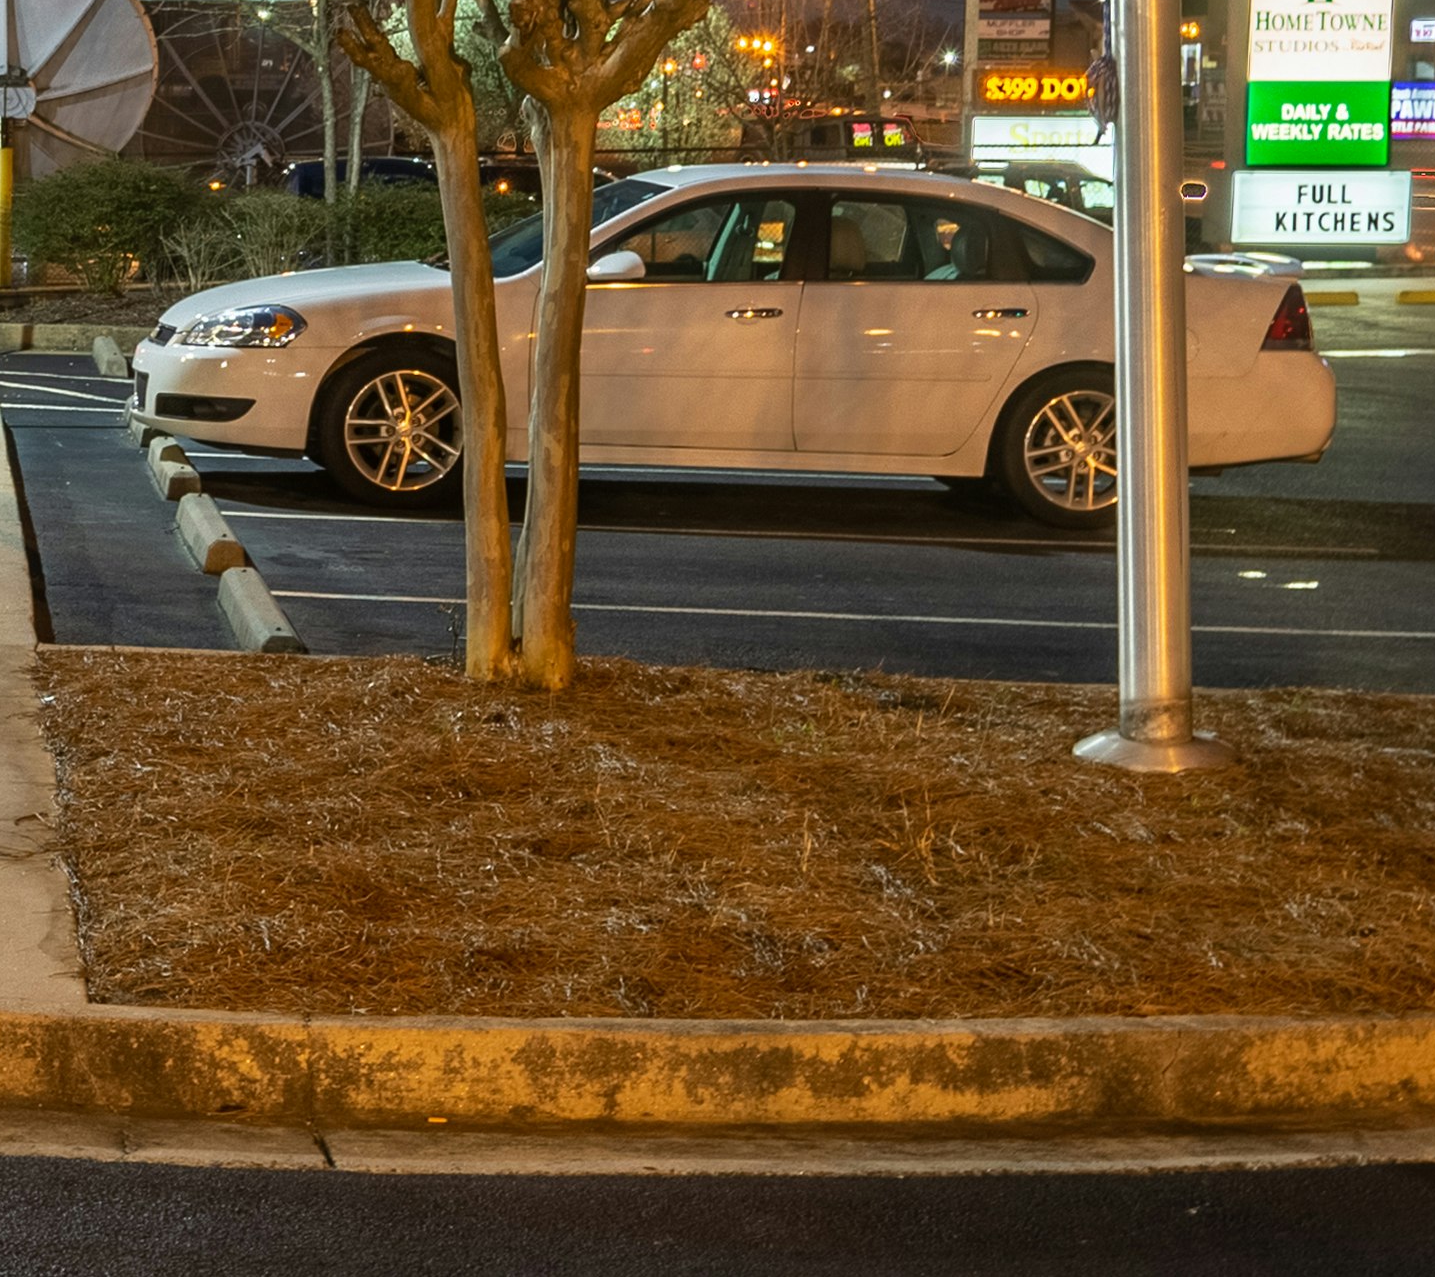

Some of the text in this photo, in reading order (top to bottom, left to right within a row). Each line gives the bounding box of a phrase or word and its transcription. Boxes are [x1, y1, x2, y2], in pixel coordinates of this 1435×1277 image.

[1254, 39, 1339, 53] STUDIOS
[1281, 103, 1349, 121] DAILY &
[1251, 123, 1385, 140] WEEKLY RATES
[1296, 184, 1353, 204] FULL
[1275, 211, 1395, 232] KITCHENS
